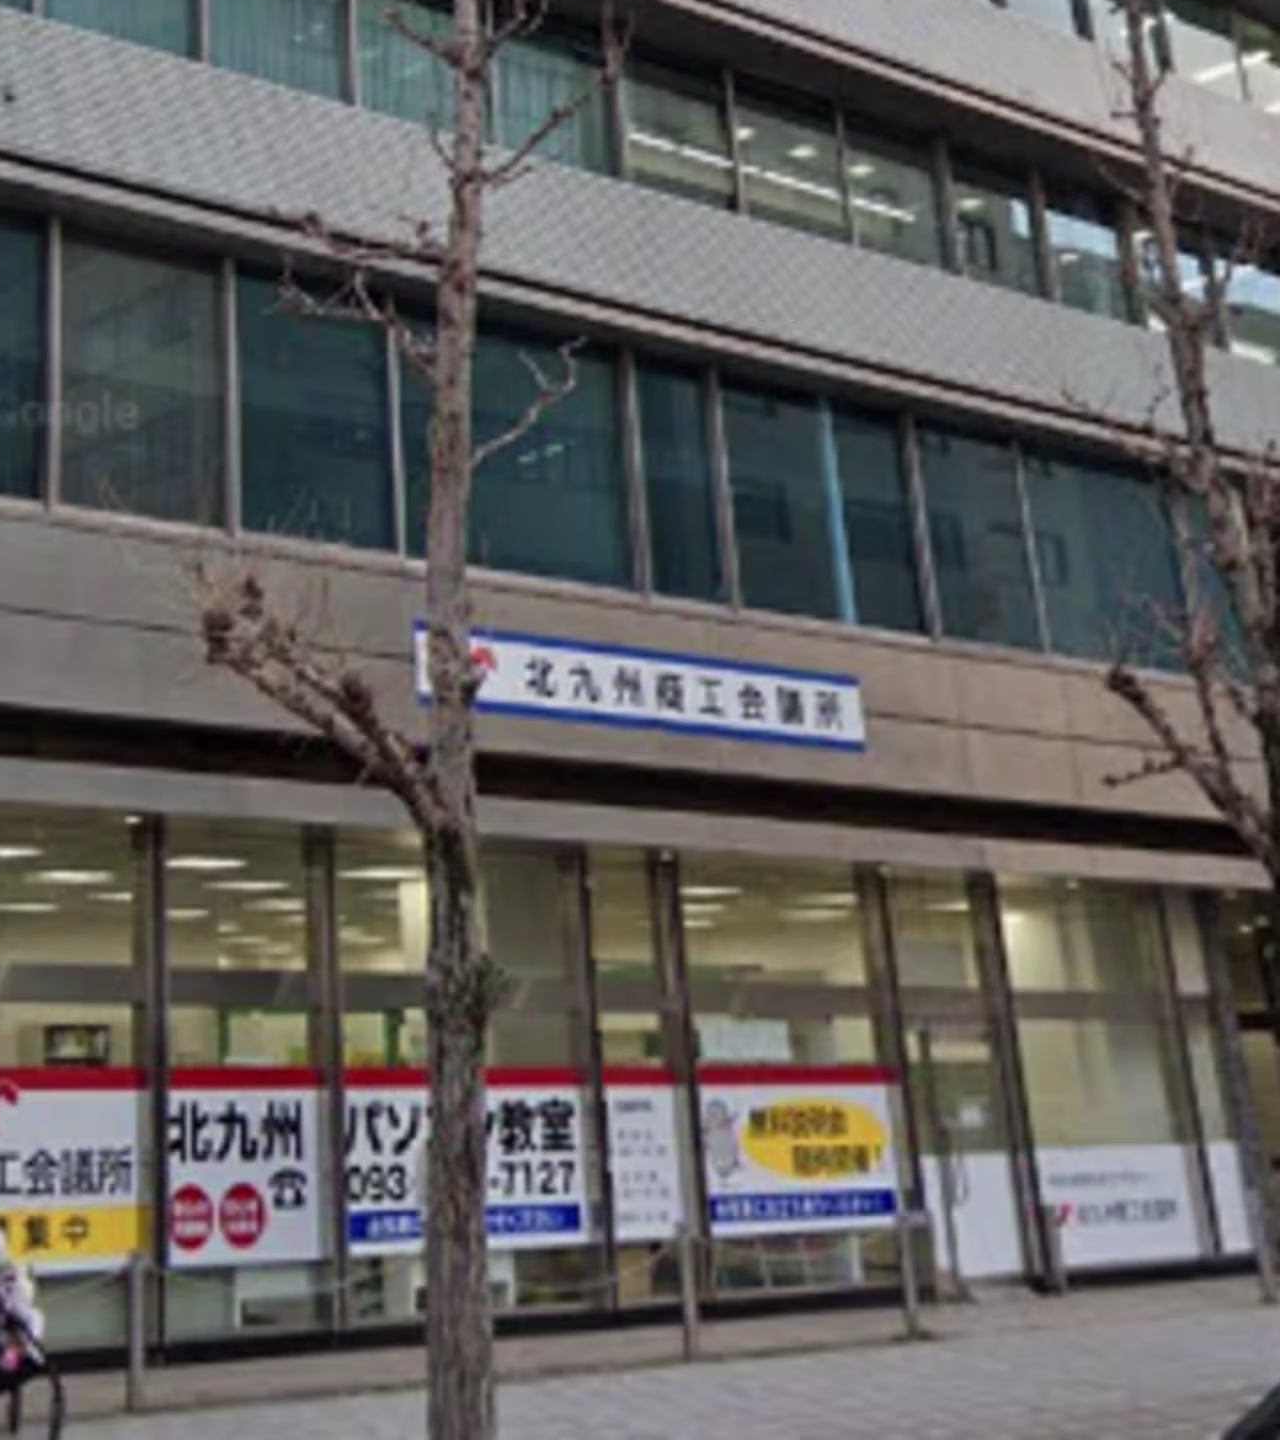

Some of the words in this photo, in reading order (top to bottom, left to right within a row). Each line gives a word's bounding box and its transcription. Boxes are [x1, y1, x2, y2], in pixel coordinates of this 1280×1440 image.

[524, 656, 845, 731] 北九州商工会議所
[168, 1100, 303, 1164] 北九州
[345, 1099, 577, 1156] パソ教室
